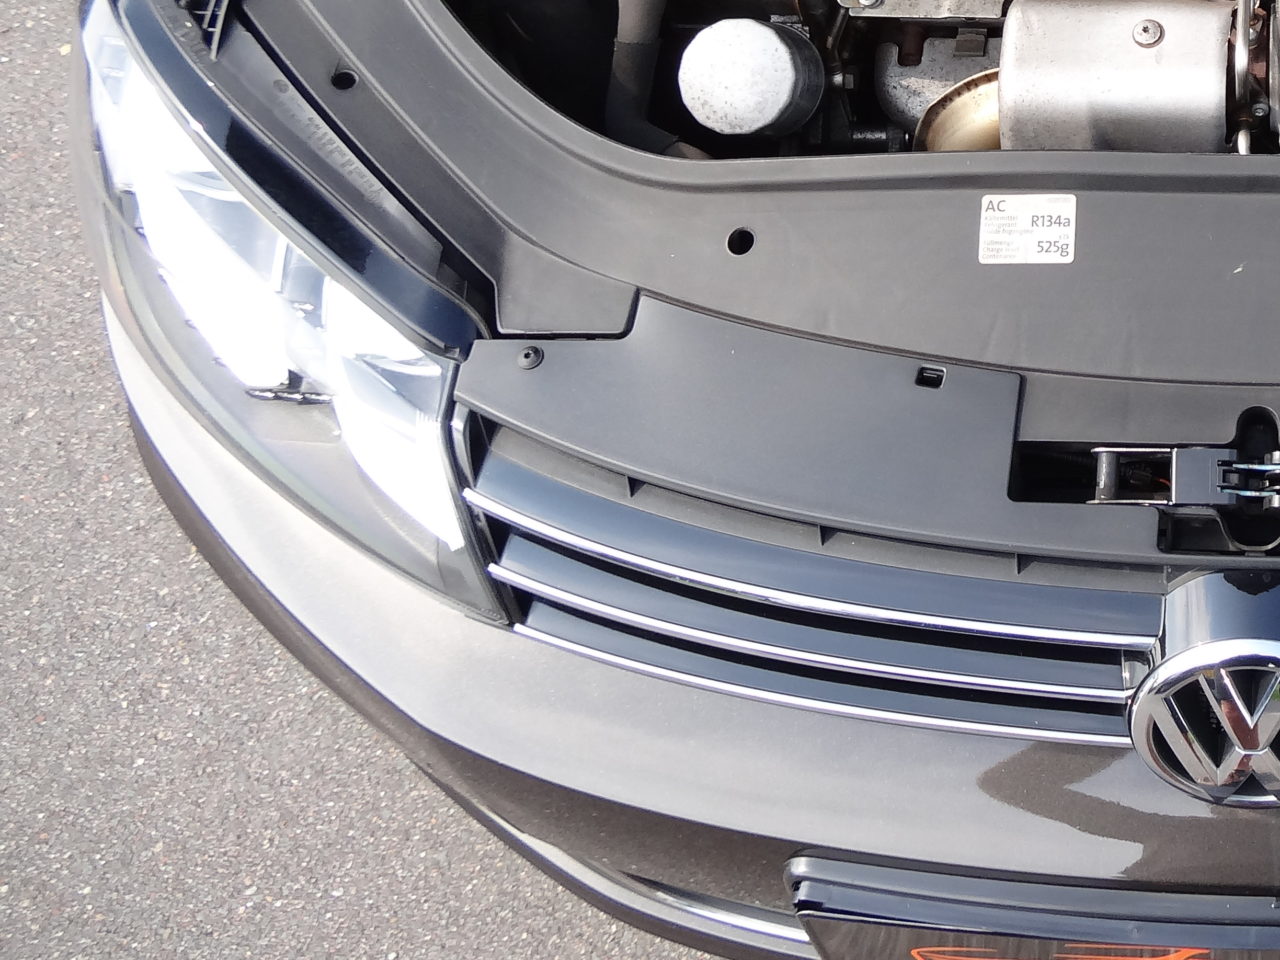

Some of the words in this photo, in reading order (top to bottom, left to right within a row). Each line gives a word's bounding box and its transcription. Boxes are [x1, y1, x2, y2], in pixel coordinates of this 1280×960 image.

[985, 200, 1006, 213] AC
[1031, 214, 1071, 228] R134a
[1037, 240, 1070, 257] 525g
